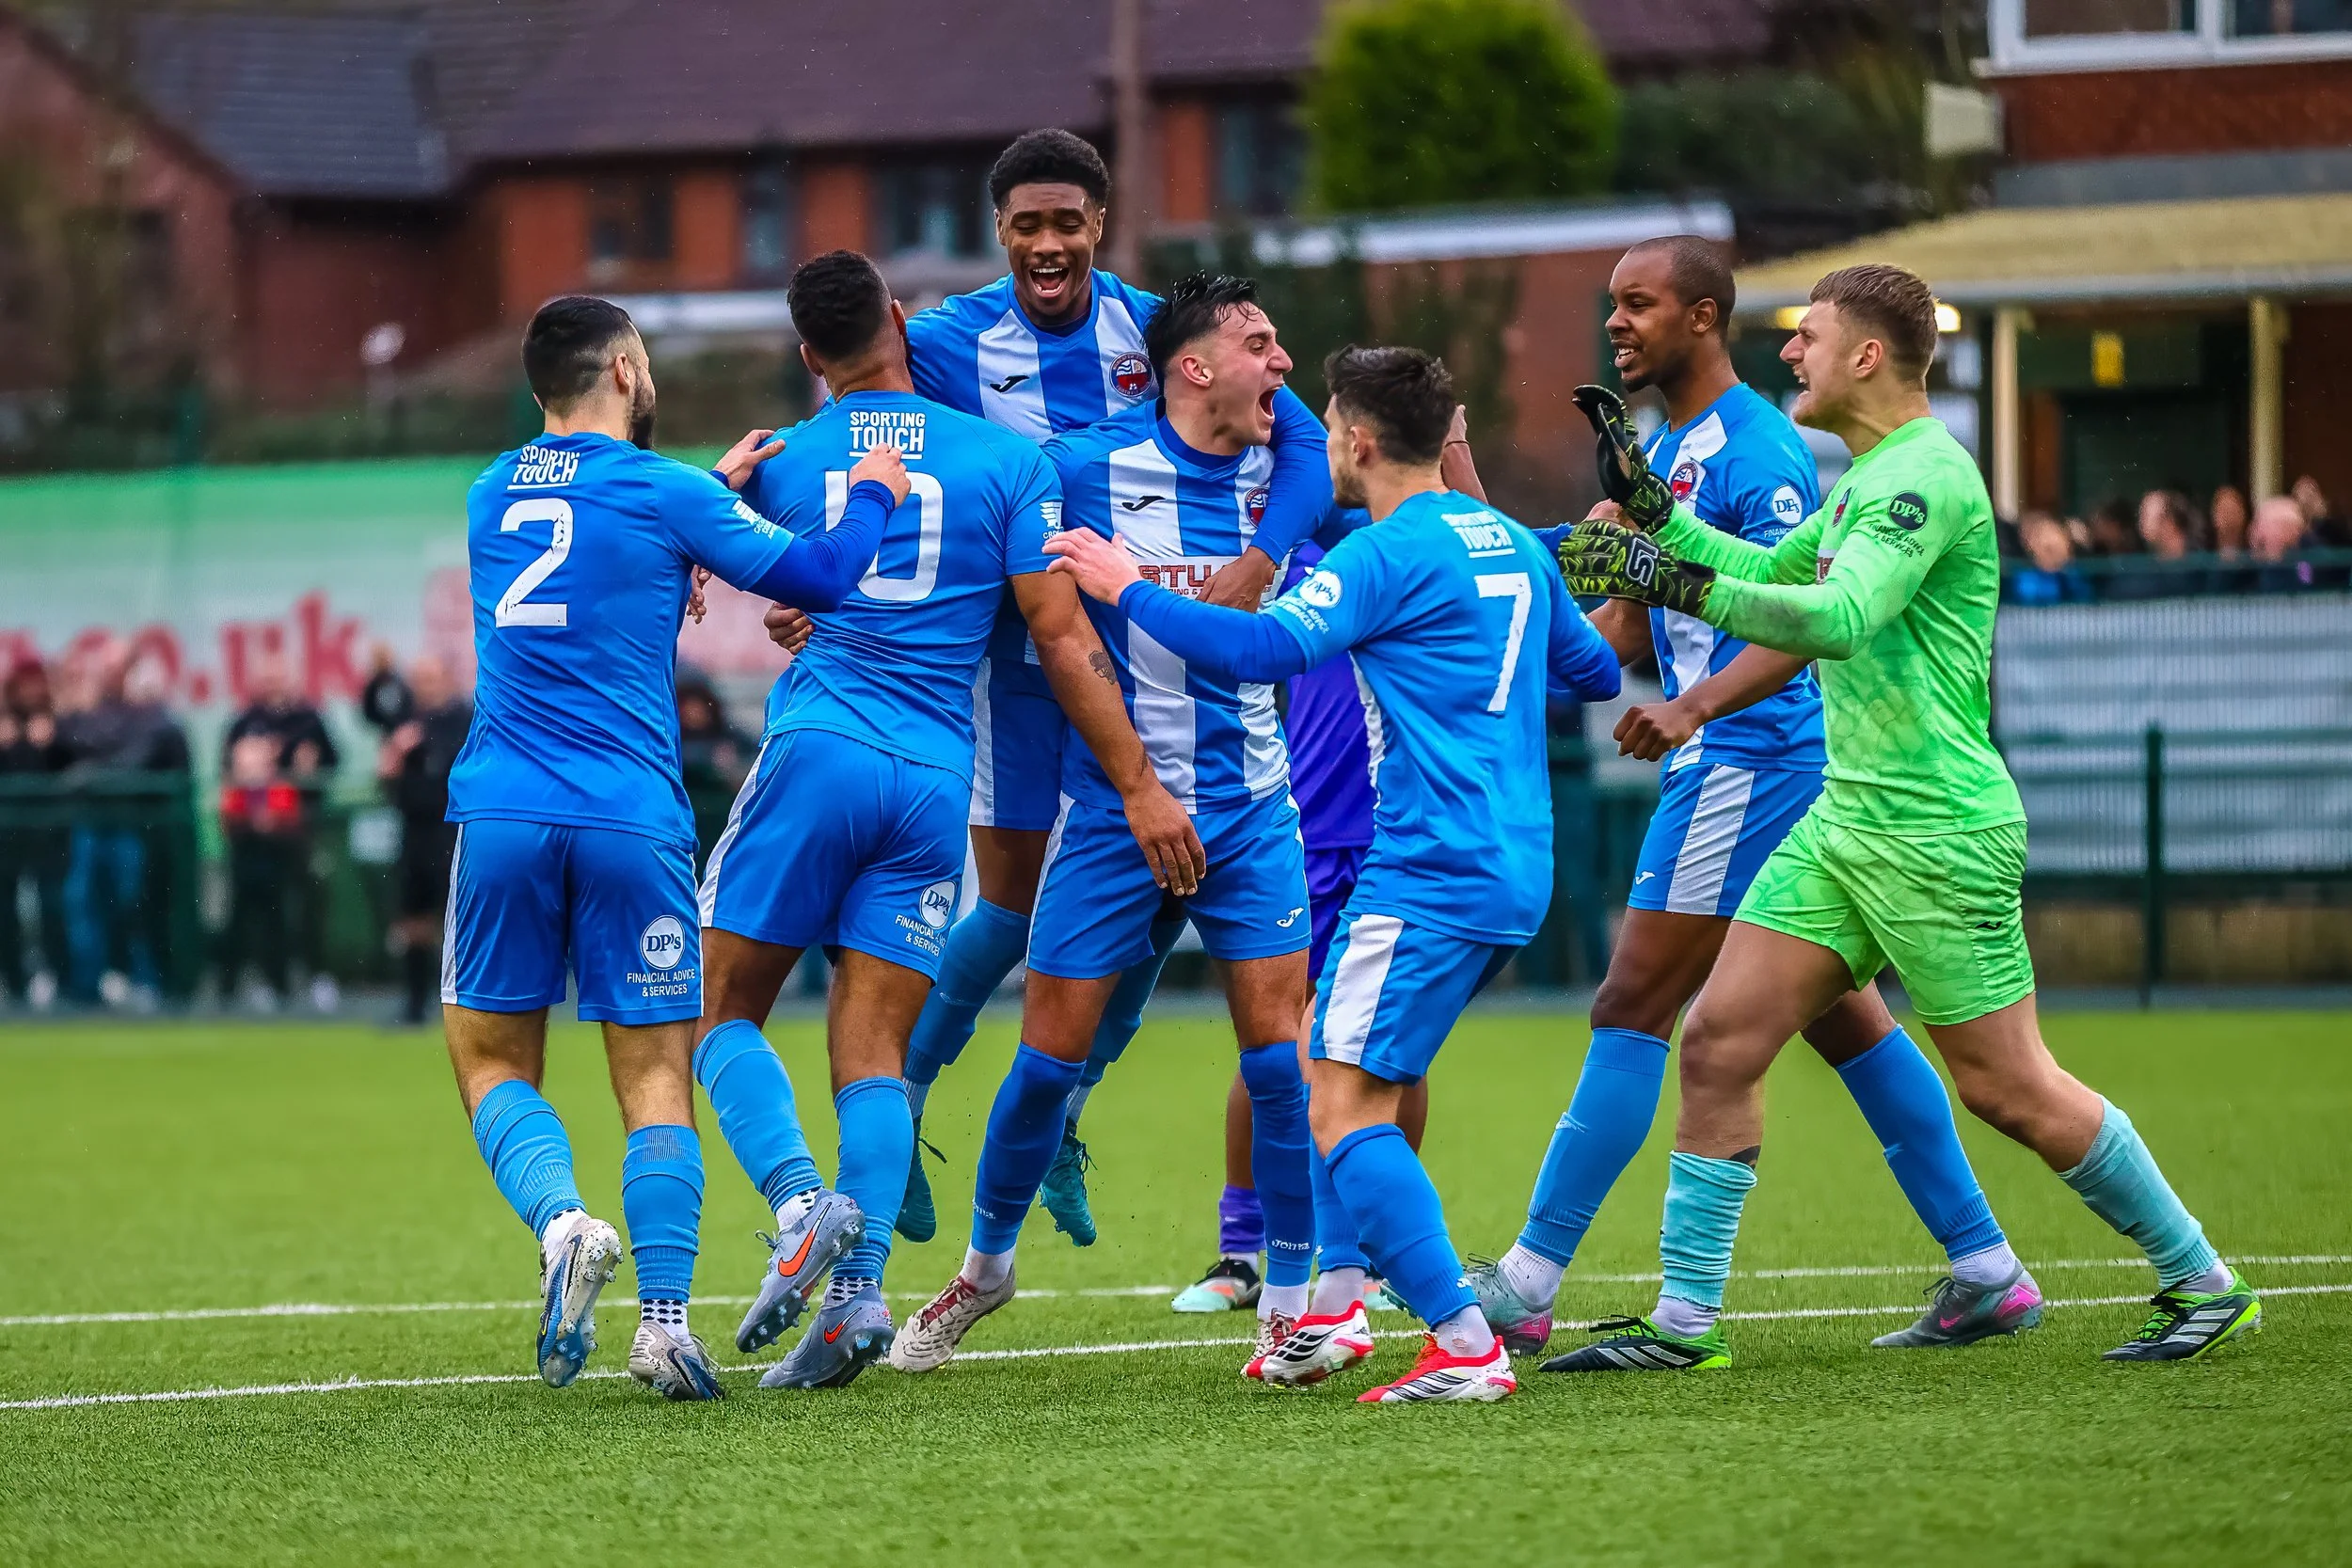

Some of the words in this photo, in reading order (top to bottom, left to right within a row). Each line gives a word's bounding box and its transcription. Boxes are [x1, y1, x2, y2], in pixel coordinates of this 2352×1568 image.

[850, 411, 926, 427] SPORTING
[850, 427, 924, 451] TOUCH
[513, 459, 579, 483] TOUCH
[495, 499, 573, 627] 2
[1474, 573, 1532, 712] 7
[895, 914, 934, 939] FINANCIAL
[646, 933, 681, 952] DP's
[905, 932, 913, 943] &
[627, 973, 671, 984] FINANCIAL
[673, 969, 696, 982] ADVICE
[642, 987, 649, 997] &
[649, 983, 688, 996] SERVICES
